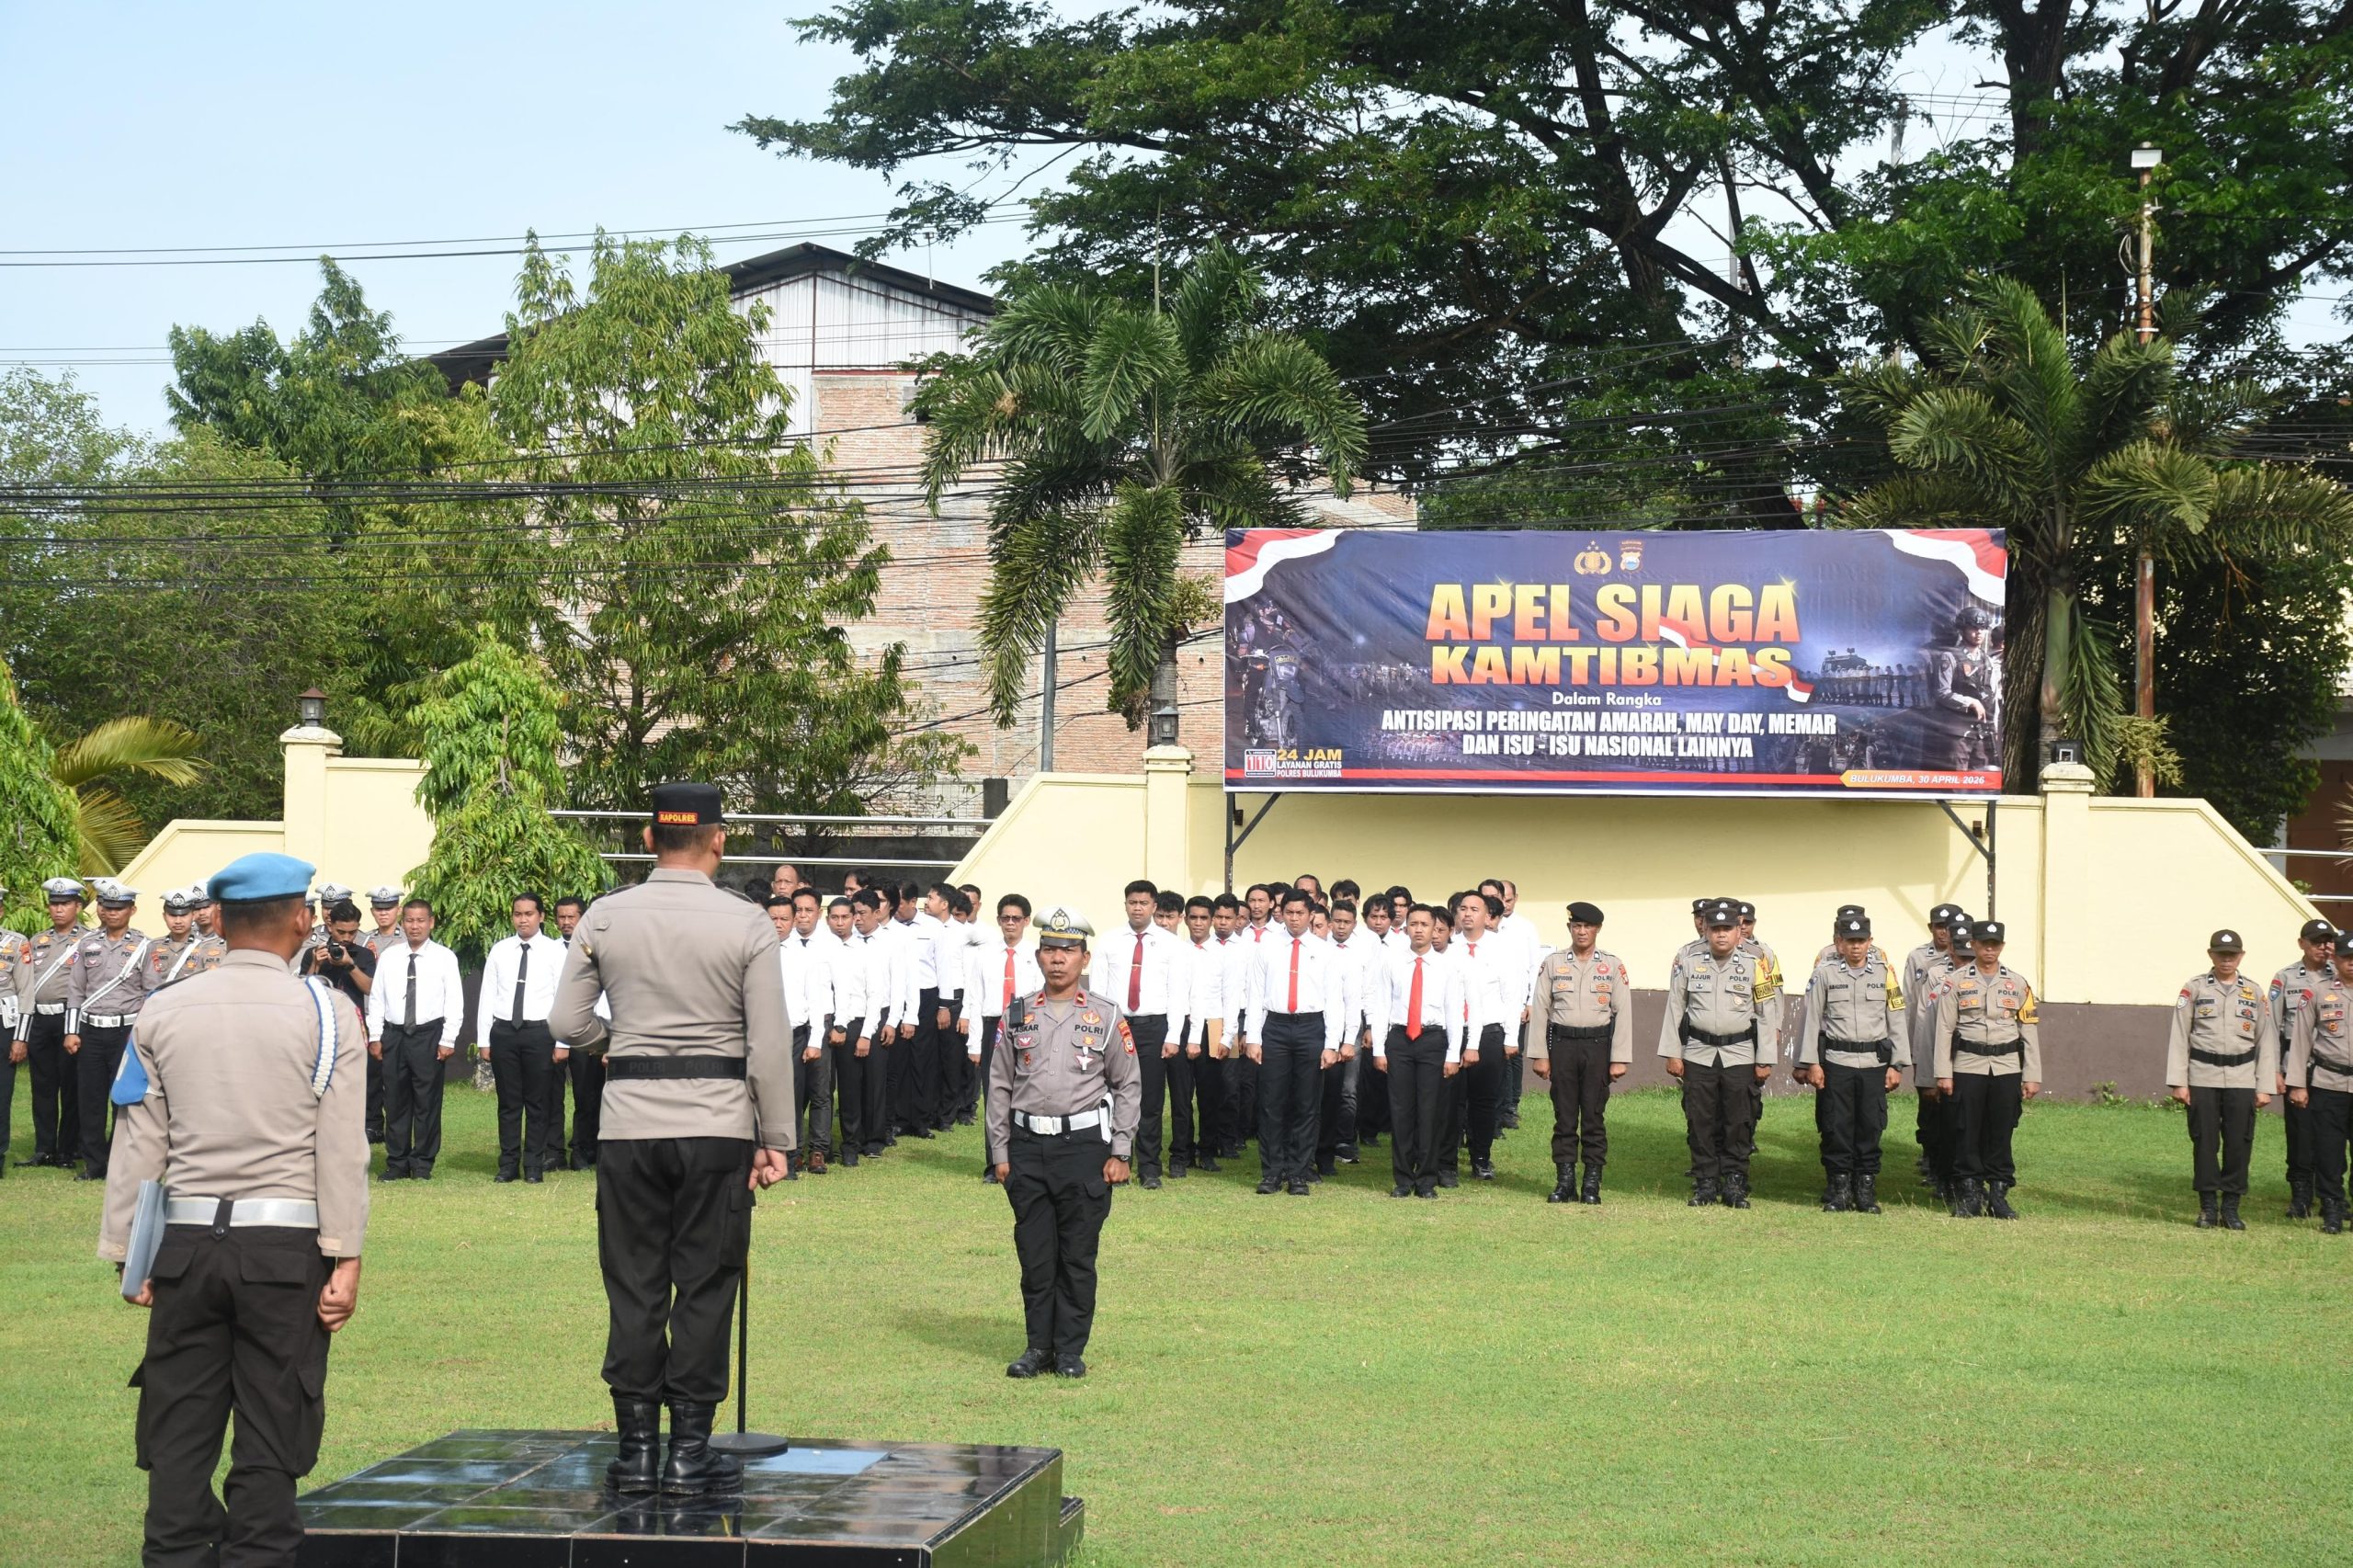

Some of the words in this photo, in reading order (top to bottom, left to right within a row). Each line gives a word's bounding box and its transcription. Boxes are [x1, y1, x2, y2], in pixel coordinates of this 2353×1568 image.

[1426, 584, 1579, 641] APEL
[1597, 584, 1801, 642] SIAGA
[1432, 645, 1792, 687] KAMTIBMAS
[1552, 691, 1601, 706] Dalam
[1606, 692, 1662, 709] Rangka
[1381, 710, 1482, 731] ANTISIPASI
[1486, 710, 1596, 733] PERINGATAN
[1599, 711, 1682, 735] AMARAH,
[1686, 712, 1725, 733] MAY
[1727, 713, 1765, 736] DAY,
[1768, 713, 1836, 735] MEMAR
[1462, 734, 1499, 756] DAN
[1503, 734, 1535, 756] ISU
[1549, 735, 1581, 756] ISU
[1585, 735, 1674, 757] NASIONAL
[1677, 736, 1754, 758] LAINNYA
[1277, 748, 1299, 761] 24
[1303, 748, 1342, 761] JAM
[1247, 756, 1274, 771] 110
[1277, 760, 1312, 769] LAYANAN
[1313, 760, 1342, 769] GRATIS
[1277, 769, 1301, 778] POLRES
[1302, 769, 1341, 778] BULUKUMBA
[1849, 774, 1915, 785] BULUKUMBA,
[1918, 775, 1929, 784] 30
[1931, 775, 1961, 785] APRIL
[1962, 776, 1985, 785] 2026
[660, 813, 696, 823] KAPOLRES
[1014, 1024, 1040, 1034] ASKAR
[1074, 1024, 1104, 1035] POLRI
[629, 1062, 665, 1074] POLRI
